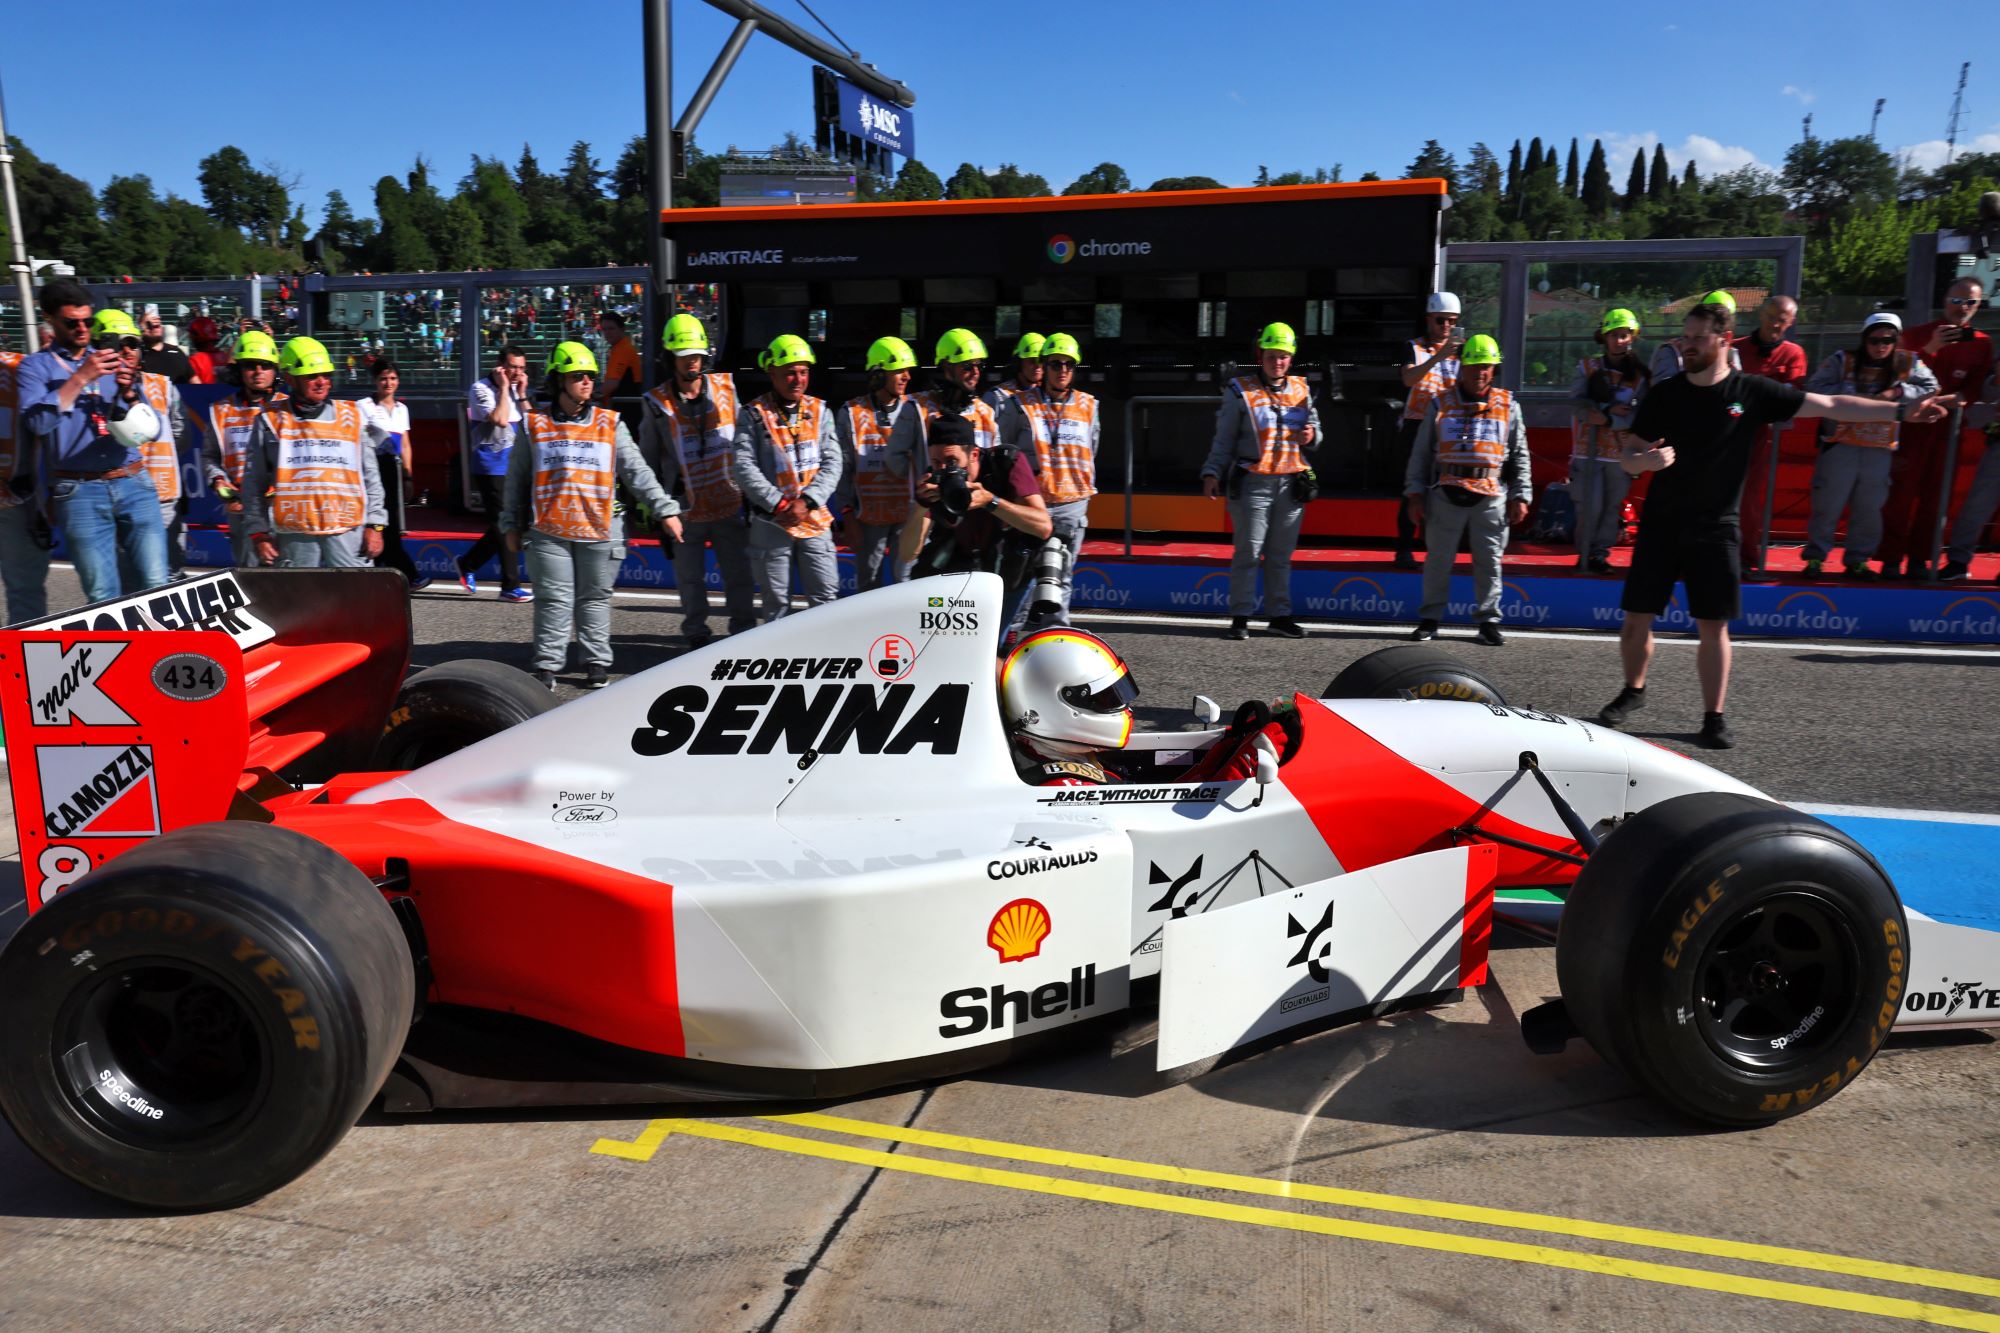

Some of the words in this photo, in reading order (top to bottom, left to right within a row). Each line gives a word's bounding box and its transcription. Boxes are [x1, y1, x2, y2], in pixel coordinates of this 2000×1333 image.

[872, 104, 901, 137] MSC
[687, 250, 783, 266] DARKTRACE
[1079, 239, 1151, 257] chrome
[618, 562, 665, 583] rkday
[947, 596, 976, 608] Senna
[1072, 583, 1131, 606] rkday
[1170, 588, 1264, 611] worky
[1306, 591, 1405, 617] workday
[919, 611, 979, 630] BOSS
[1746, 606, 1860, 635] workday
[885, 639, 900, 659] E
[163, 664, 216, 690] 434
[710, 657, 863, 681] #FOREVER
[36, 647, 93, 723] mart
[630, 683, 970, 757] SENNA
[1048, 761, 1105, 782] BOSS
[46, 745, 153, 838] CAMOZZI
[559, 791, 597, 801] Power
[600, 790, 615, 801] by
[1054, 789, 1100, 801] RACE
[1099, 788, 1172, 800] WITHOUT
[1172, 787, 1221, 799] TRACE
[564, 807, 605, 822] Ford
[987, 850, 1098, 881] COURTAULDS
[1662, 878, 1726, 970] EAGLE
[938, 962, 1097, 1039] Shell
[1281, 990, 1329, 1011] COURTAULDS
[1770, 1005, 1825, 1050] speedline
[99, 1068, 164, 1121] speedline
